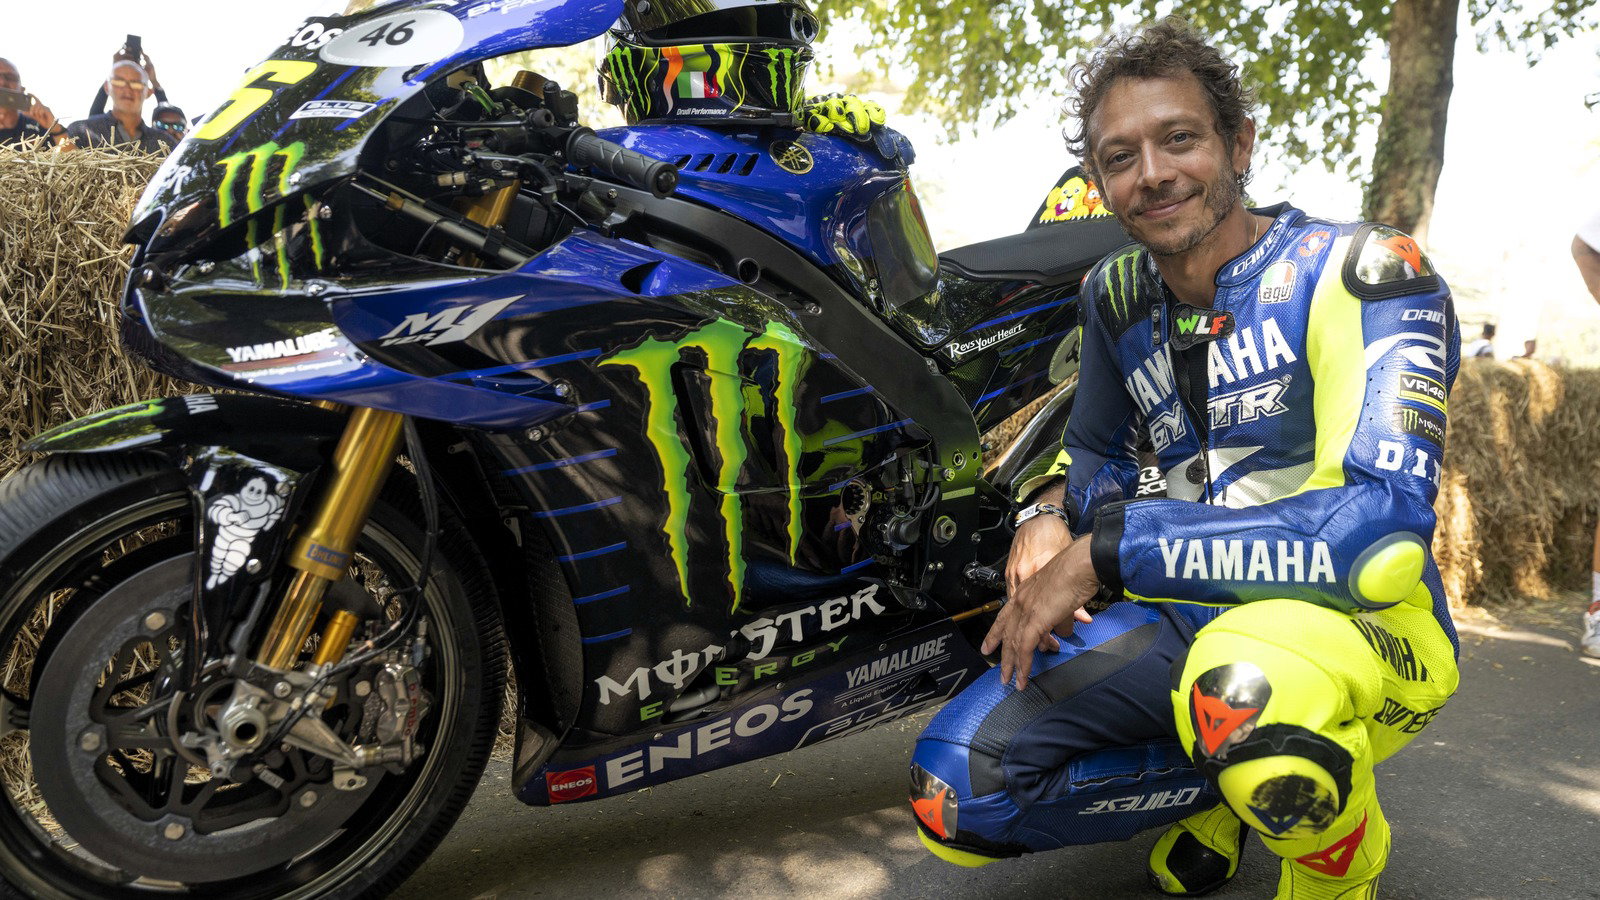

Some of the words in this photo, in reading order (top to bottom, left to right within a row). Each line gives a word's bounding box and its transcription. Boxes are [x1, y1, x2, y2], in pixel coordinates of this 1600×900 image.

[358, 19, 416, 47] 46
[691, 107, 727, 115] Performance
[1231, 213, 1291, 278] DAINESE
[377, 293, 527, 347] M1
[1176, 314, 1227, 335] WLF
[226, 327, 338, 363] YAMALUBE
[945, 338, 976, 359] Revs
[975, 332, 998, 351] Your
[997, 323, 1024, 341] Heart
[1064, 337, 1081, 364] 4
[1158, 537, 1337, 583] YAMAHA
[640, 635, 849, 722] EERGY
[846, 636, 947, 689] YAMALUBE
[849, 692, 872, 705] Liquid
[605, 688, 814, 790] ENEOS
[551, 777, 593, 792] ENEOS
[1078, 787, 1201, 815] DAINESE
